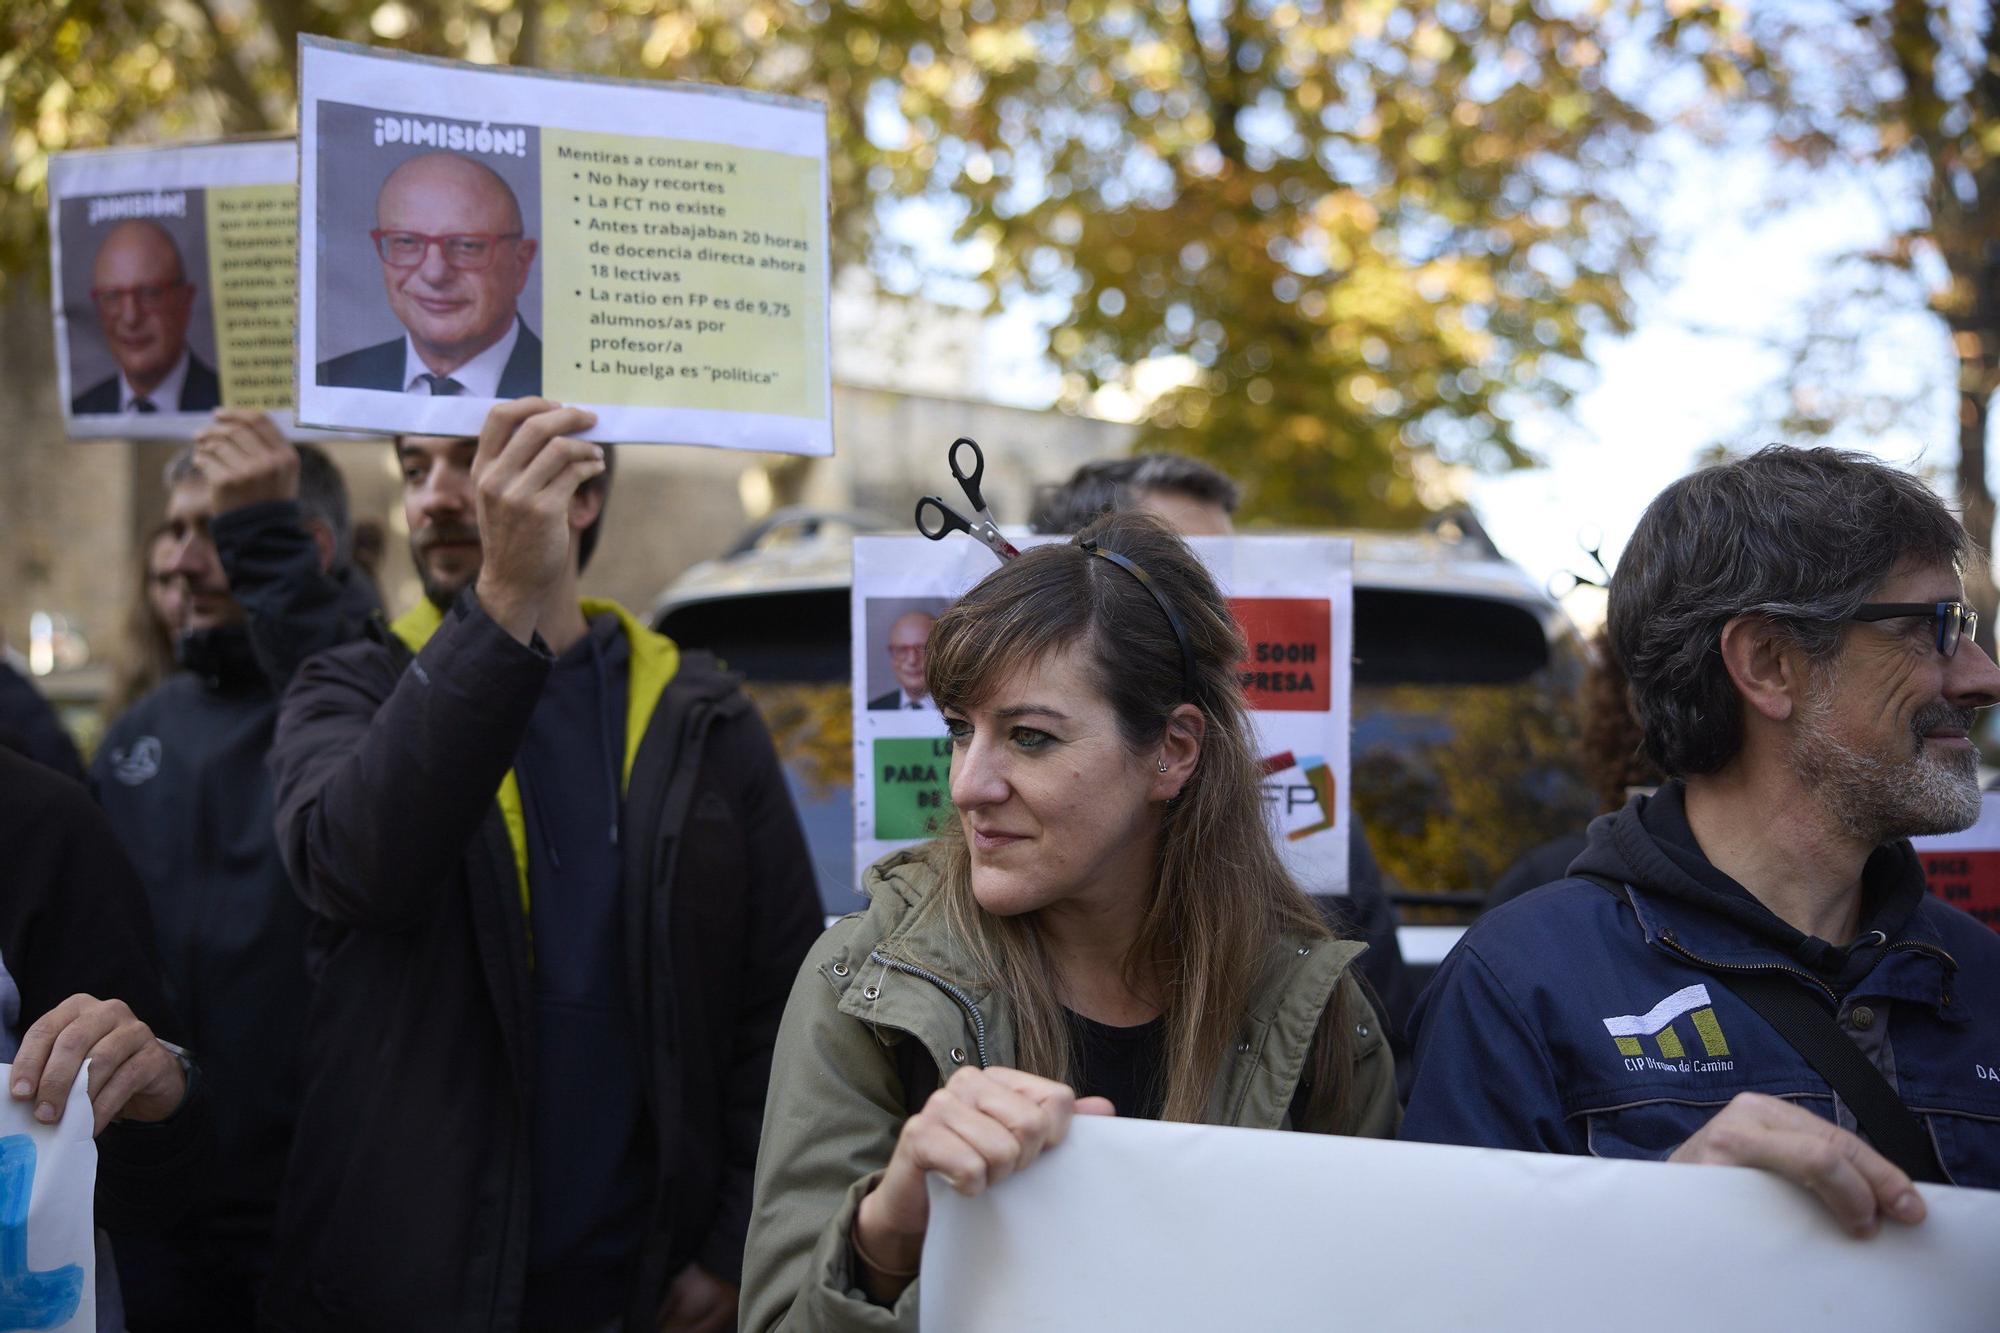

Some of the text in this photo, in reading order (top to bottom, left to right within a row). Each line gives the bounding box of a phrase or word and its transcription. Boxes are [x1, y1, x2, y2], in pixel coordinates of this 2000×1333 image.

[374, 117, 526, 158] ¡DIMISIÓN!
[558, 146, 629, 165] Mentiras
[634, 156, 643, 166] a
[648, 155, 699, 170] contar
[704, 160, 723, 172] en
[588, 171, 725, 194] No hay recortes
[588, 195, 726, 217] La FCT no existe
[588, 218, 808, 251] Antes trabajaban 20 horas
[589, 240, 806, 273] de docencia directa ahora
[591, 264, 681, 282] 18 lectivas
[590, 287, 791, 318] La ratio en FP es de 9,75
[590, 310, 726, 334] alumnos/as por
[590, 337, 683, 353] profesor/a
[590, 360, 610, 374] La
[616, 361, 675, 381] huelga
[680, 366, 699, 379] es
[883, 764, 938, 784] PARA
[1624, 1058, 1645, 1072] CIP
[1693, 1060, 1735, 1073] Camino
